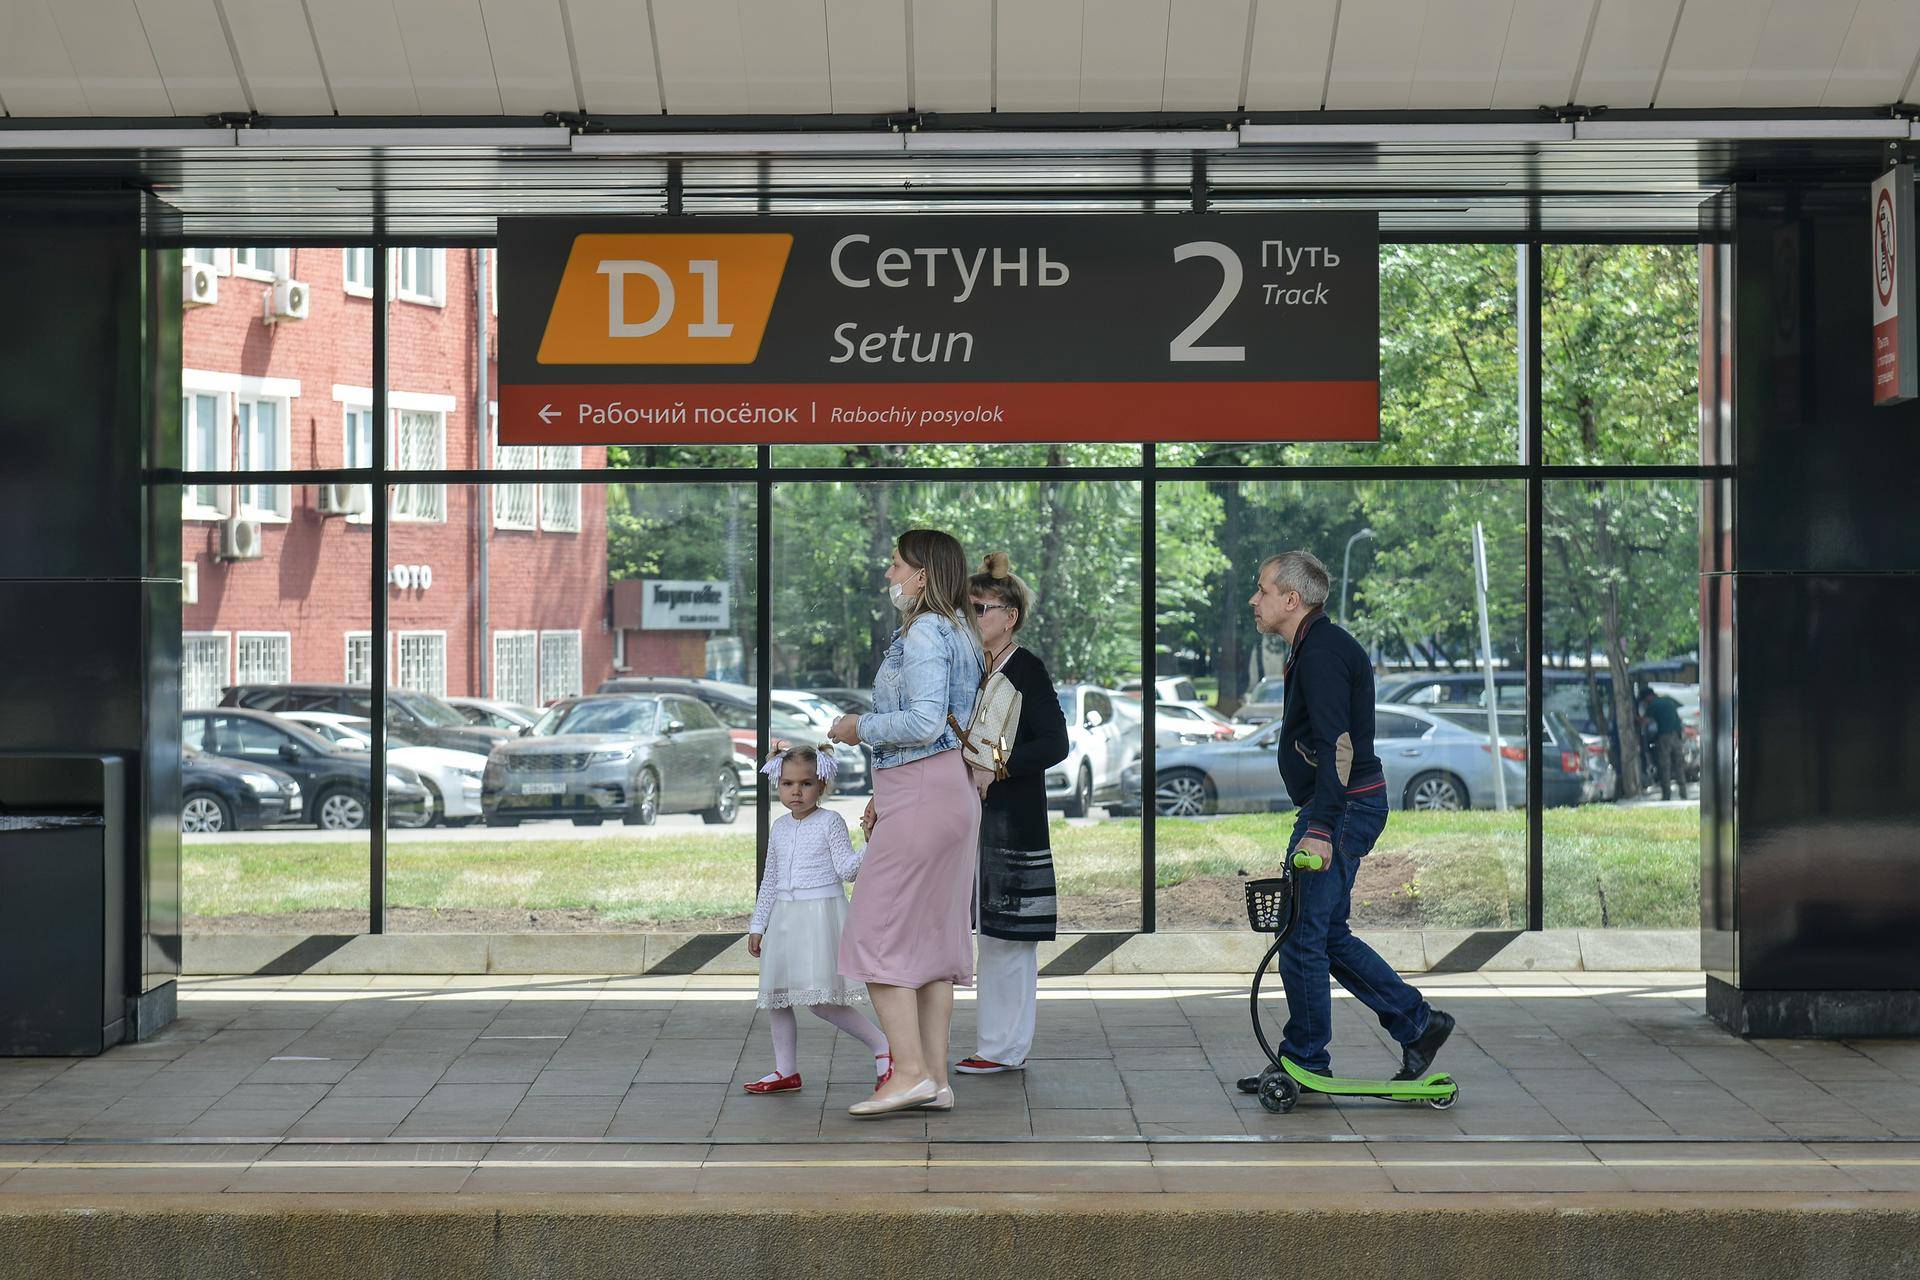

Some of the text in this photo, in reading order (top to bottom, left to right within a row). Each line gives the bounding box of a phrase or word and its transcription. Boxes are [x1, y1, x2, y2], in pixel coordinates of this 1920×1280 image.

[830, 233, 1070, 303] Сетунь
[1261, 240, 1341, 276] Путь
[596, 259, 734, 337] D1
[1170, 241, 1245, 361] 2
[1262, 282, 1330, 305] Track
[829, 322, 974, 364] Setun
[579, 401, 798, 424] Рабочий посёлок
[830, 405, 1005, 427] Rabochiy posyolok
[388, 564, 432, 590] ОТО
